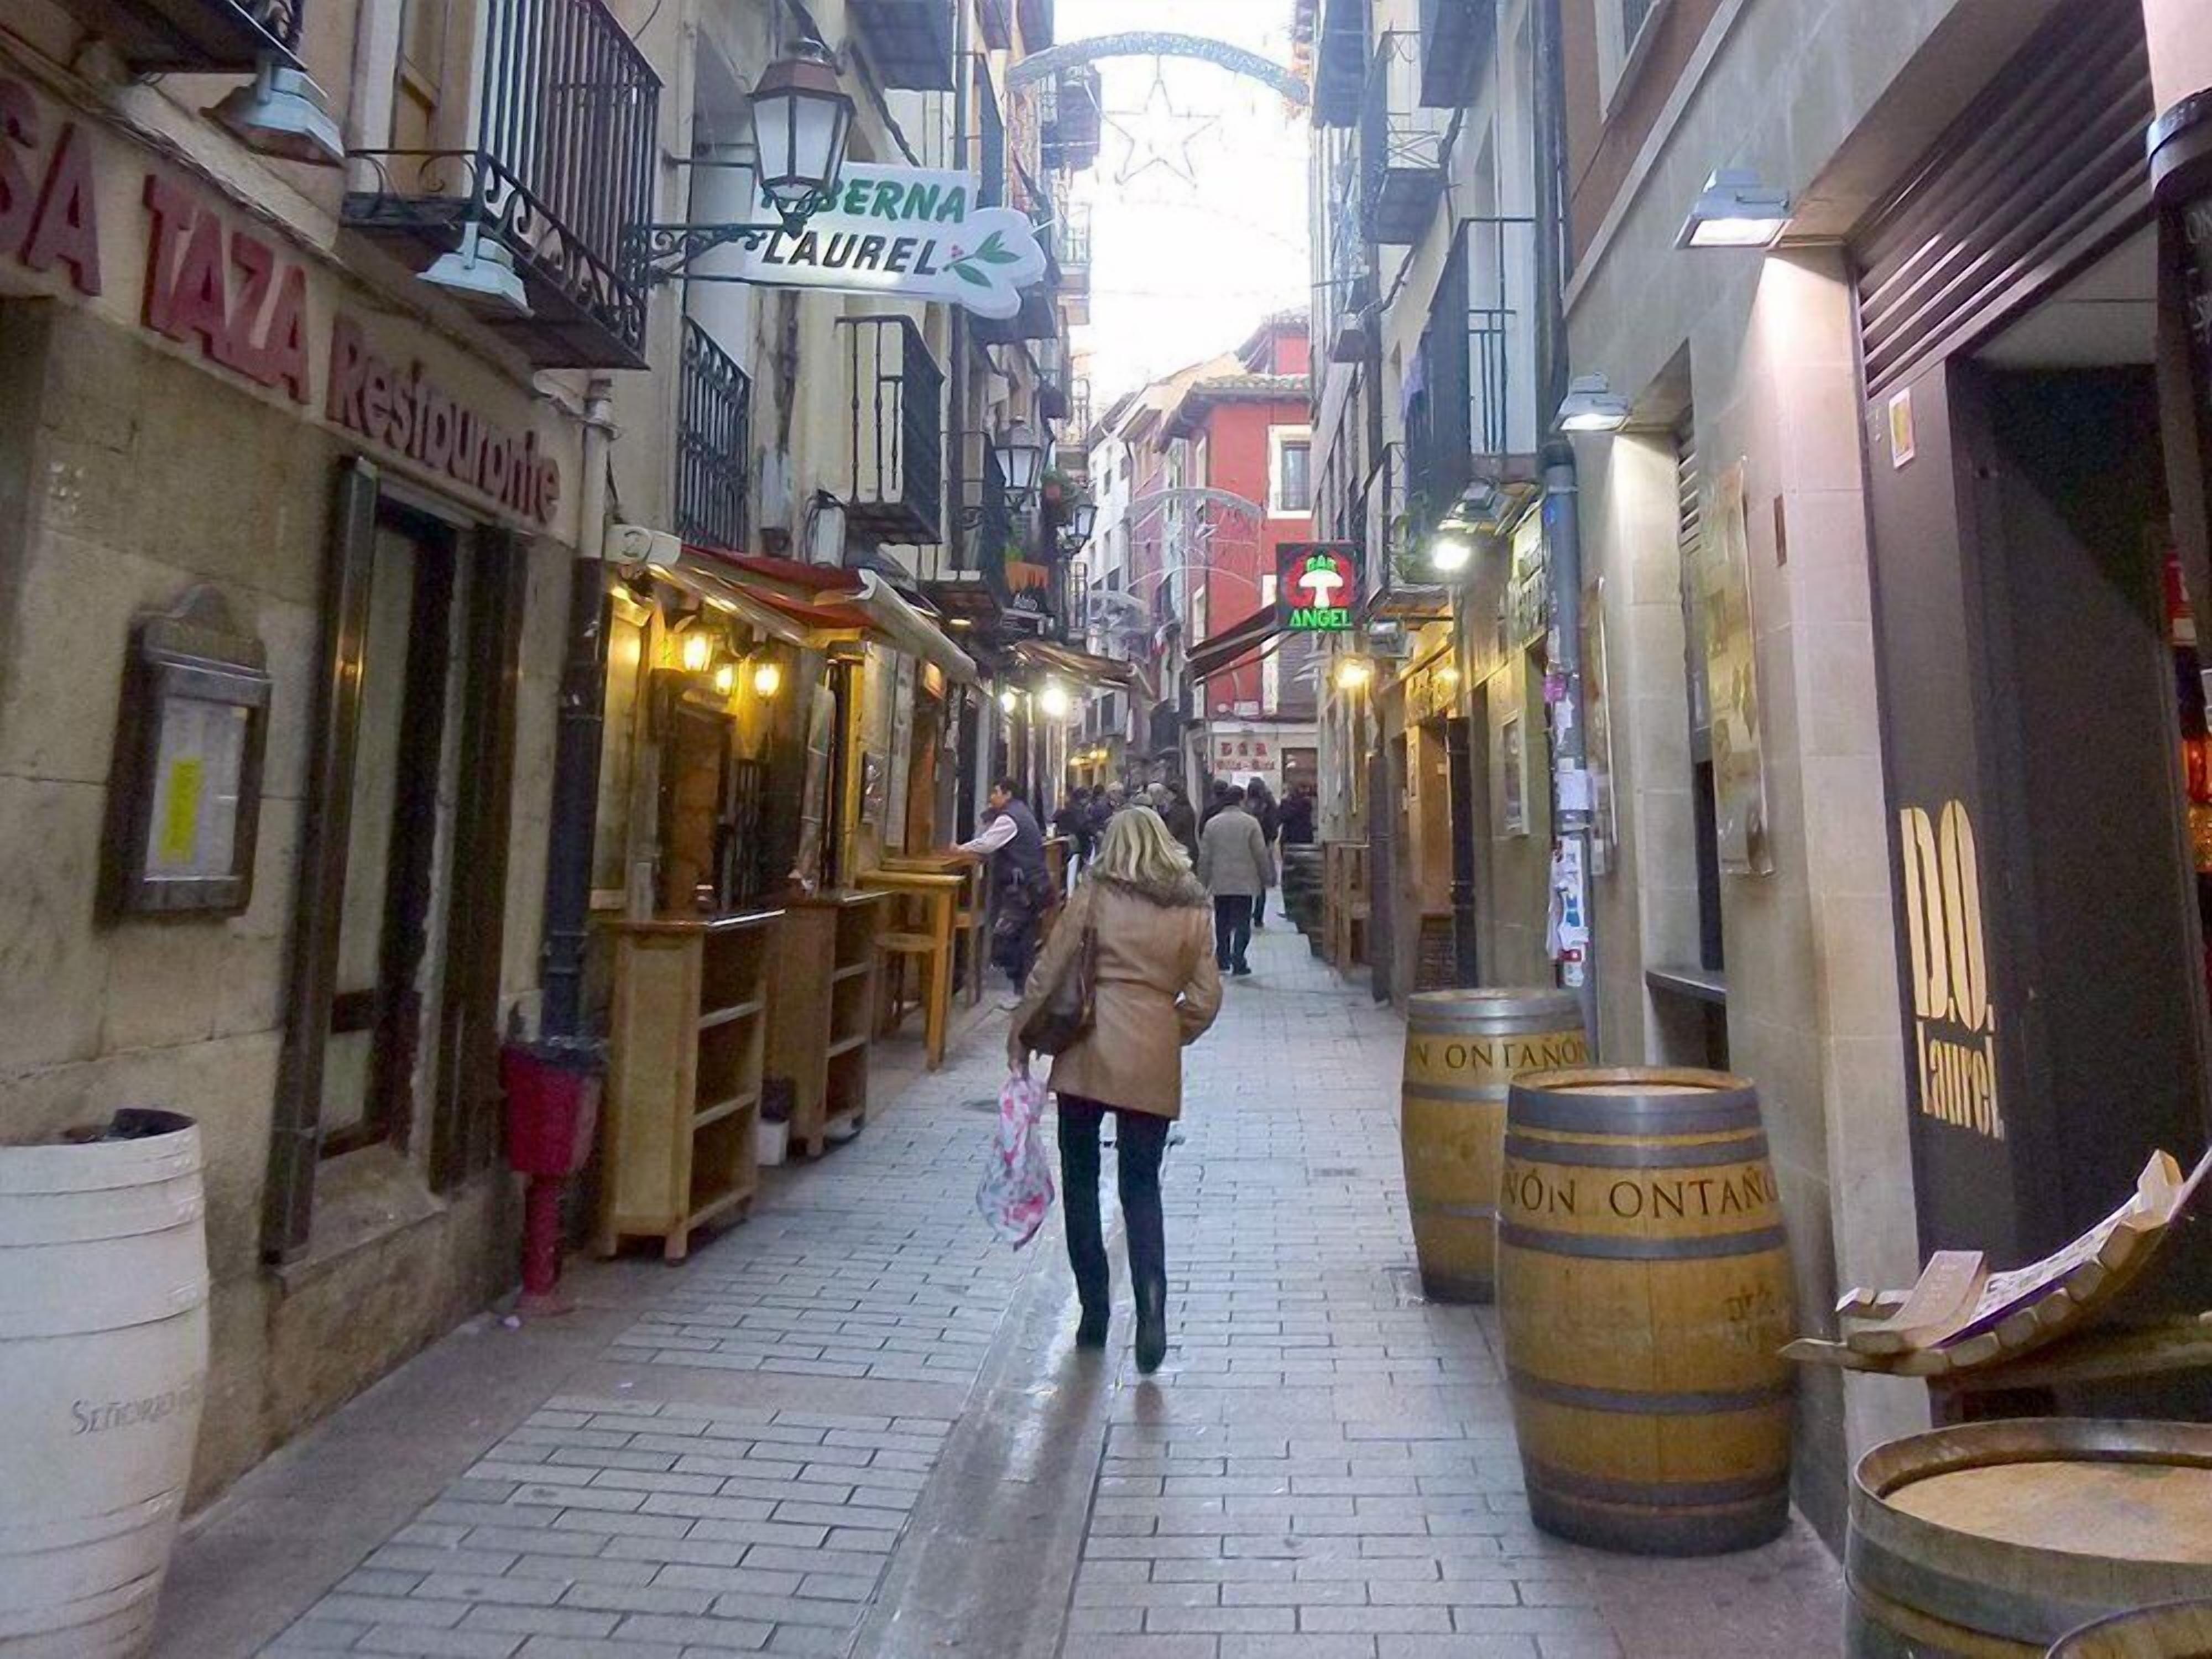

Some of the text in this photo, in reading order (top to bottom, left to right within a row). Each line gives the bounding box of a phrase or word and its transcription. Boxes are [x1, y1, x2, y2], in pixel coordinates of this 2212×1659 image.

[761, 178, 967, 223] BERNA
[761, 226, 937, 276] LAUREL
[142, 174, 311, 405] TAZA
[325, 312, 561, 524] Restaurante
[1288, 608, 1354, 627] ANGEL
